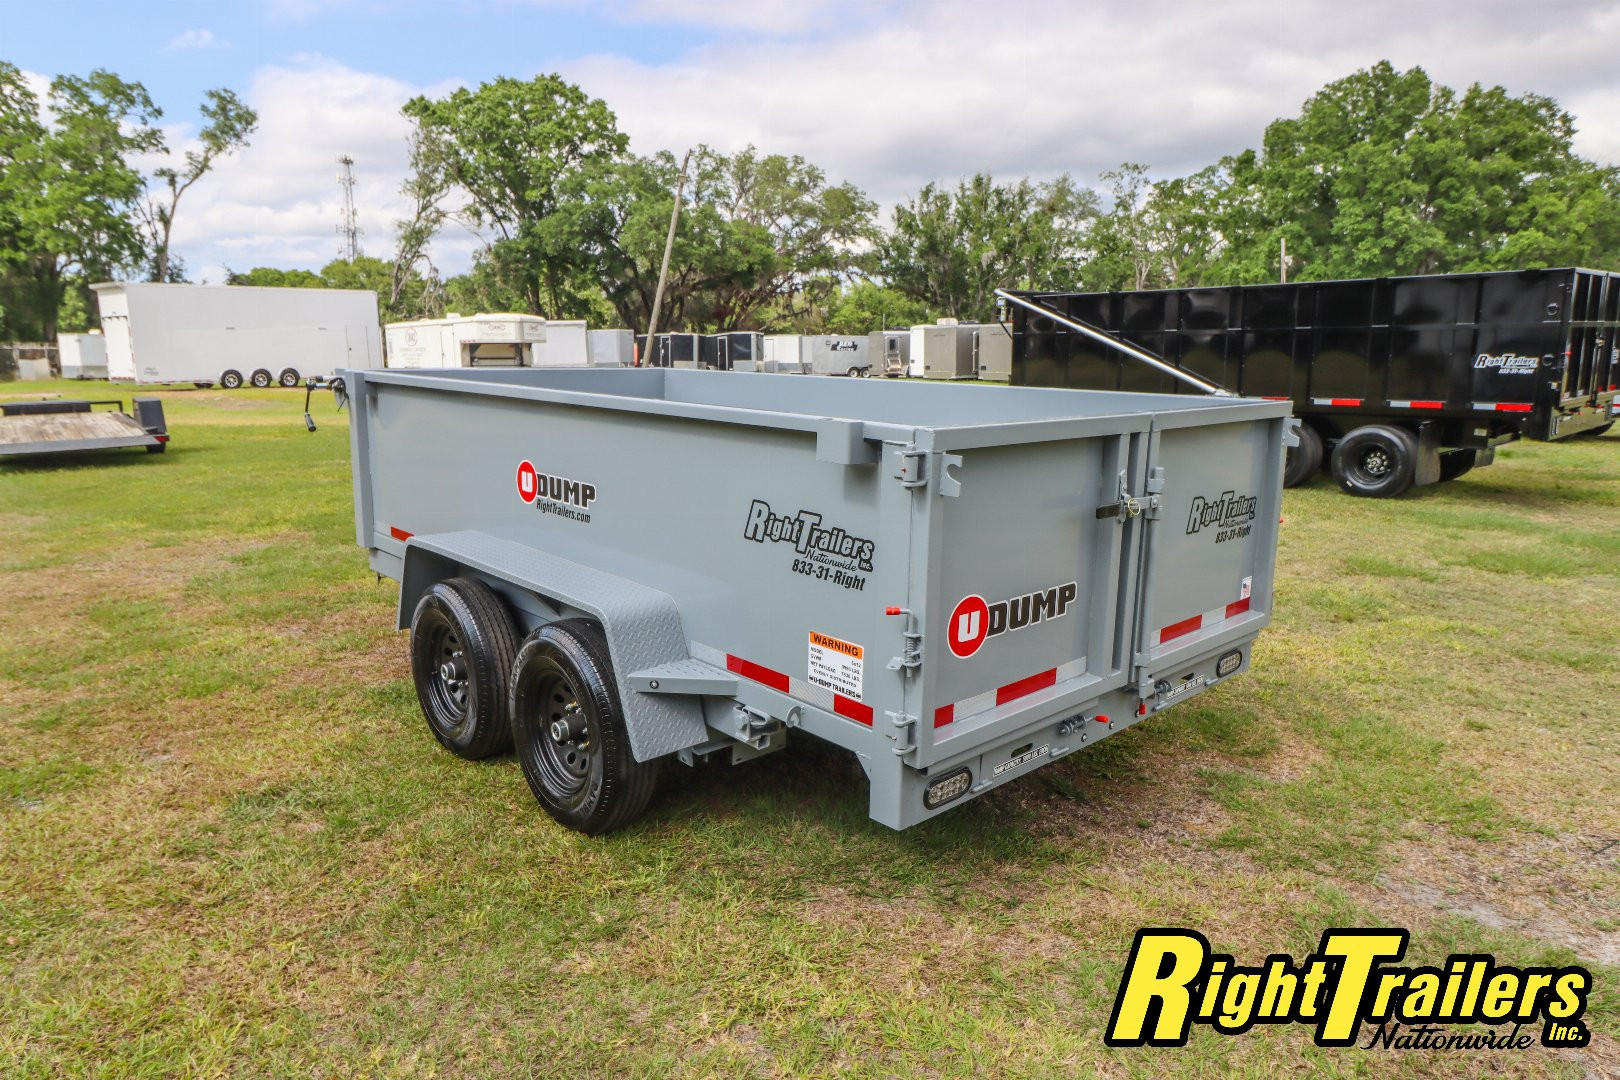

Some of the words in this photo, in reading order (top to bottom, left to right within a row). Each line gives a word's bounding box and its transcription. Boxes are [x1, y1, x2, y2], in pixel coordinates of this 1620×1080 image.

[536, 499, 591, 523] RightTrailers.com
[803, 548, 857, 572] Nationwide
[792, 558, 866, 591] 833-31-Right
[813, 633, 859, 656] WARNING
[813, 677, 832, 687] U-DUMP
[832, 684, 856, 698] TRAILERS
